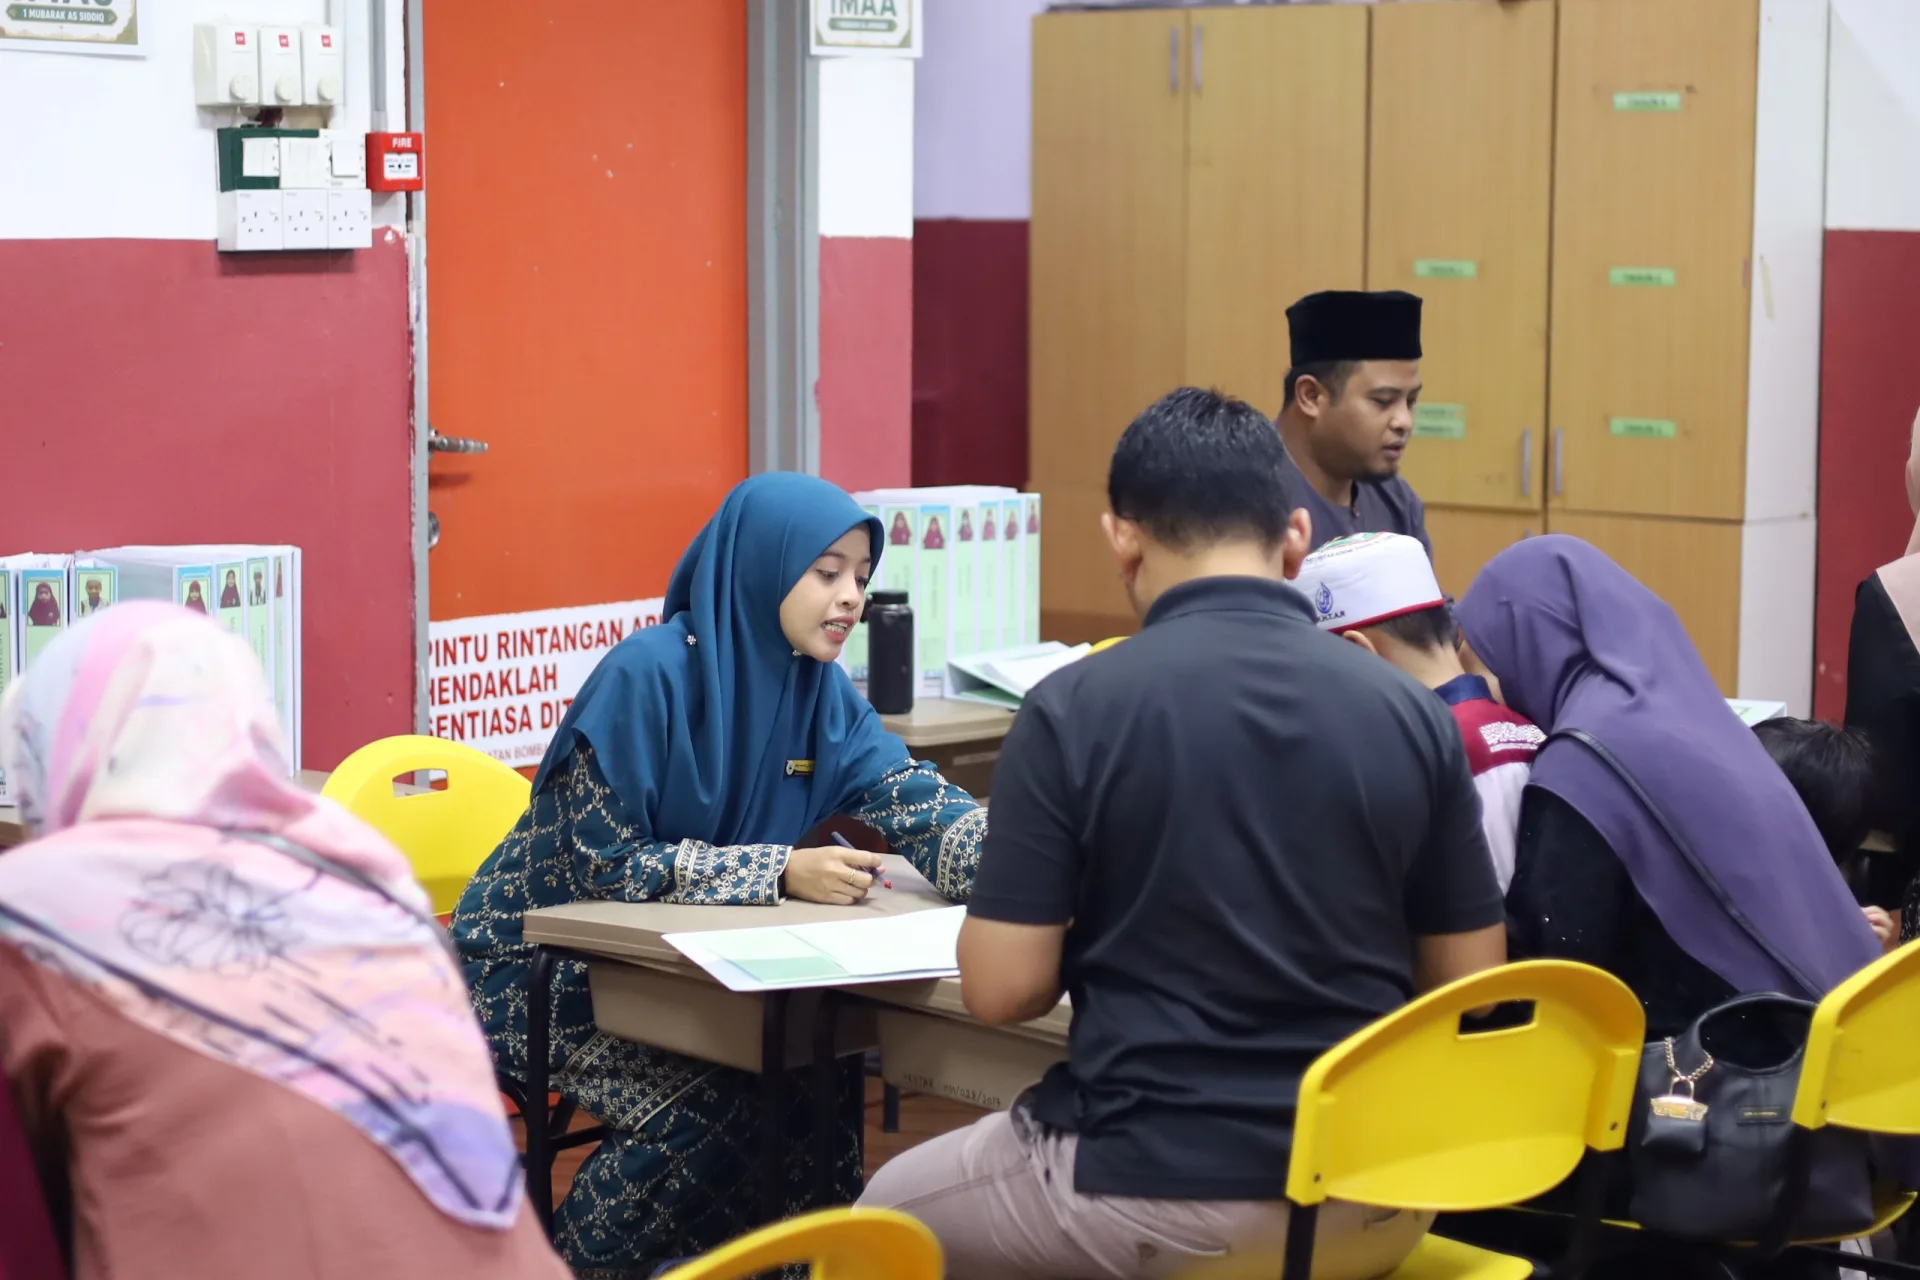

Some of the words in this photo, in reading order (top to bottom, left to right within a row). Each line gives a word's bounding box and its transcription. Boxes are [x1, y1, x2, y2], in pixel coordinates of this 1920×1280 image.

[22, 8, 27, 18] 1
[28, 8, 66, 20] MUBARAK
[67, 11, 78, 21] AS
[79, 12, 105, 23] SIDDIQ
[392, 137, 413, 148] FIRE
[497, 618, 623, 660] RINTANGAN
